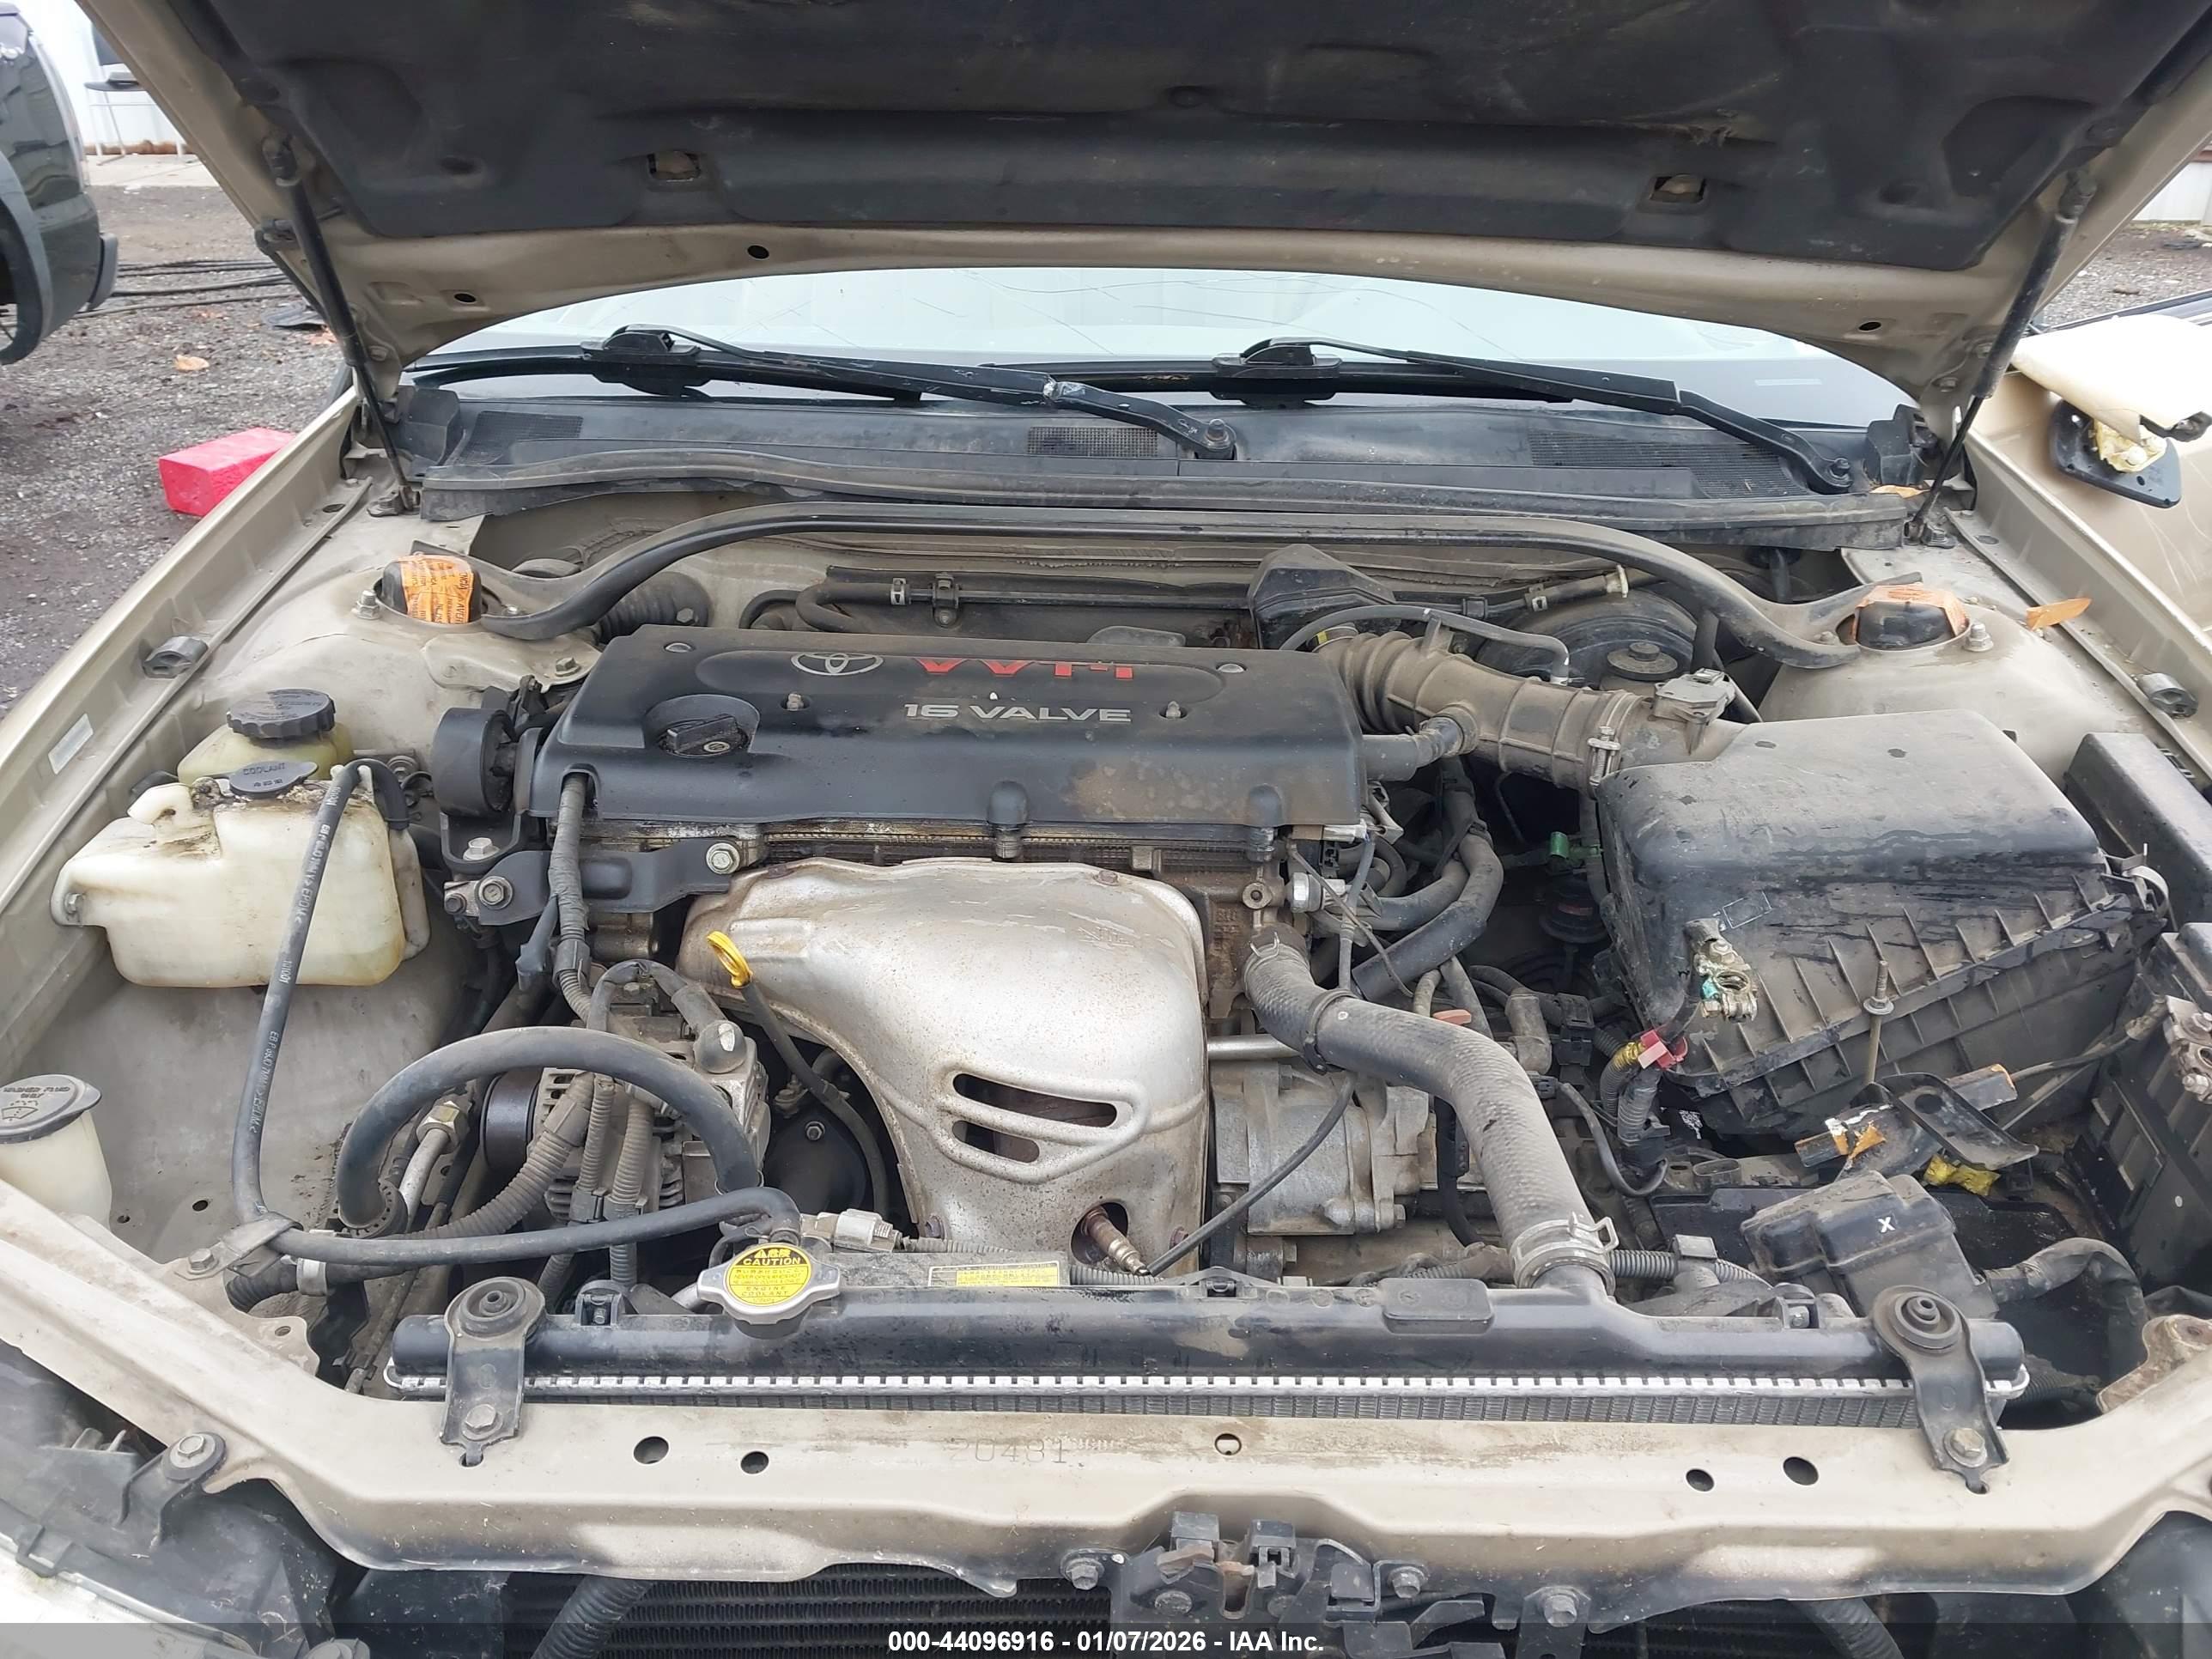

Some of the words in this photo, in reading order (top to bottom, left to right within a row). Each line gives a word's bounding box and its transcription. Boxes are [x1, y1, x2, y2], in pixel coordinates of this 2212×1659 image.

[904, 703, 959, 718] 16
[969, 705, 1132, 723] VALVE
[743, 1257, 801, 1266] CAUTION
